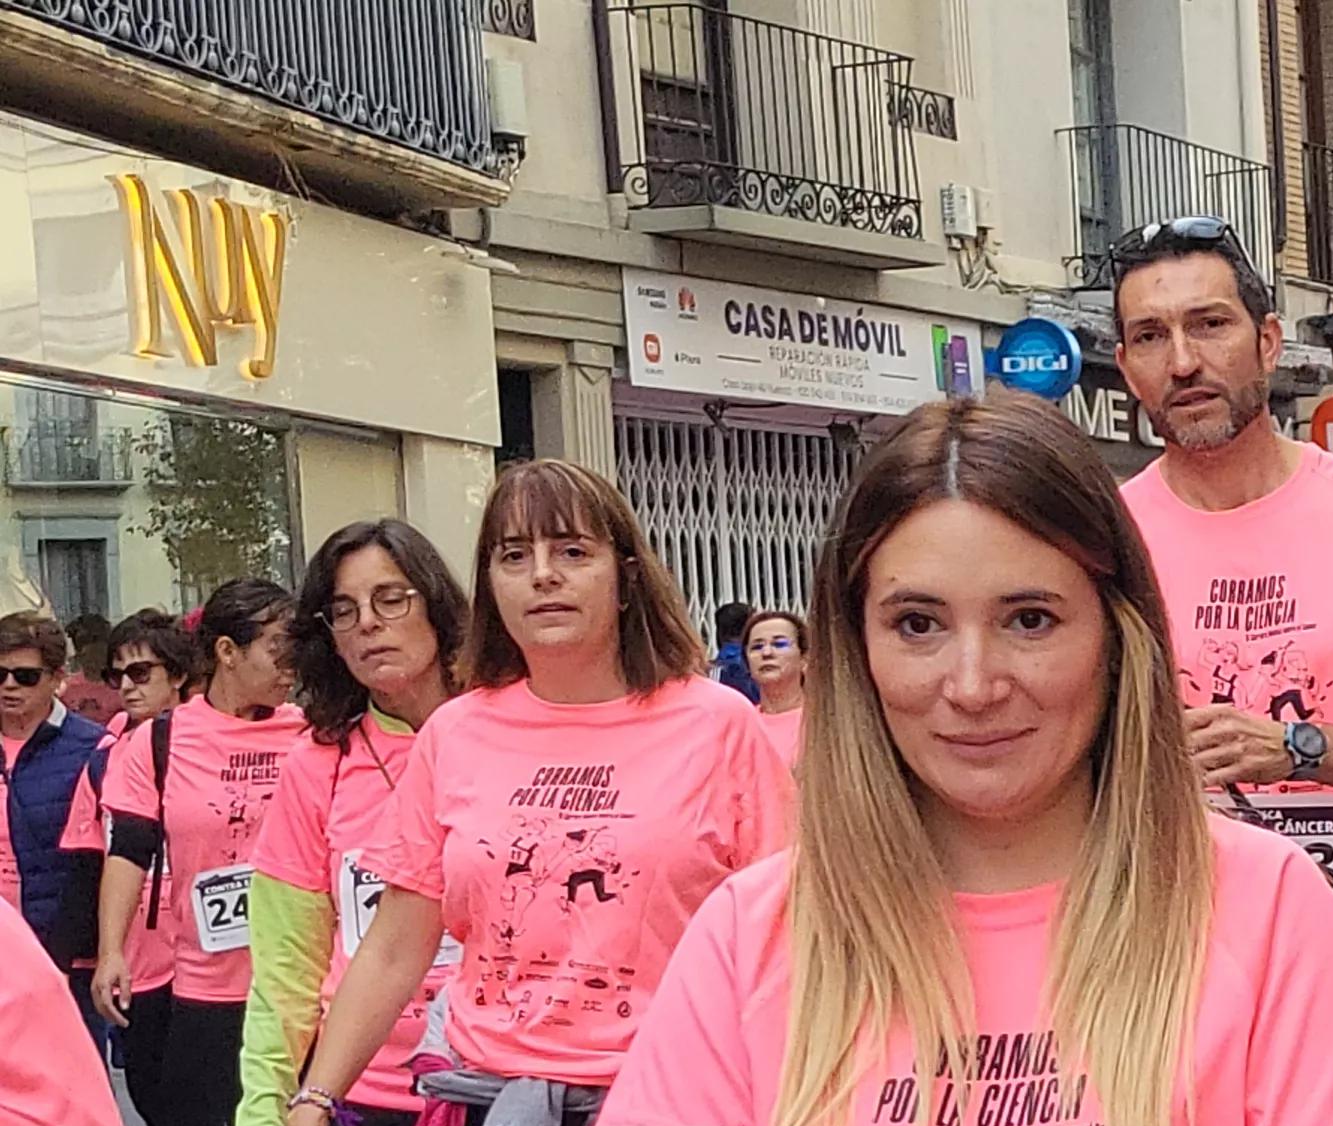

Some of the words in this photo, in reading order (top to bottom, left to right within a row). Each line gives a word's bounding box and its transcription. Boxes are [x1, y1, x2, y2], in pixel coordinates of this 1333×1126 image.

[724, 299, 794, 343] CASA
[798, 310, 829, 347] DE
[832, 307, 908, 358] MÓVIL
[768, 345, 833, 367] REPARACIÓN
[835, 354, 871, 373] RÁPIDA
[1002, 354, 1068, 374] DIGI
[779, 362, 823, 384] MÓVILES
[825, 370, 864, 389] NUEVOS
[1209, 575, 1287, 605] CORRAMOS
[1194, 604, 1223, 630] POR
[1226, 604, 1240, 631] LA
[1244, 598, 1297, 633] CIENCIA
[229, 751, 278, 769] CORRAMOS
[221, 768, 236, 782] POR
[239, 768, 249, 782] LA
[531, 764, 615, 788] CORRAMOS
[508, 788, 538, 807] POR
[539, 788, 558, 809] LA
[559, 788, 620, 813] CIENCIA
[912, 1030, 1060, 1081] ORRAMO
